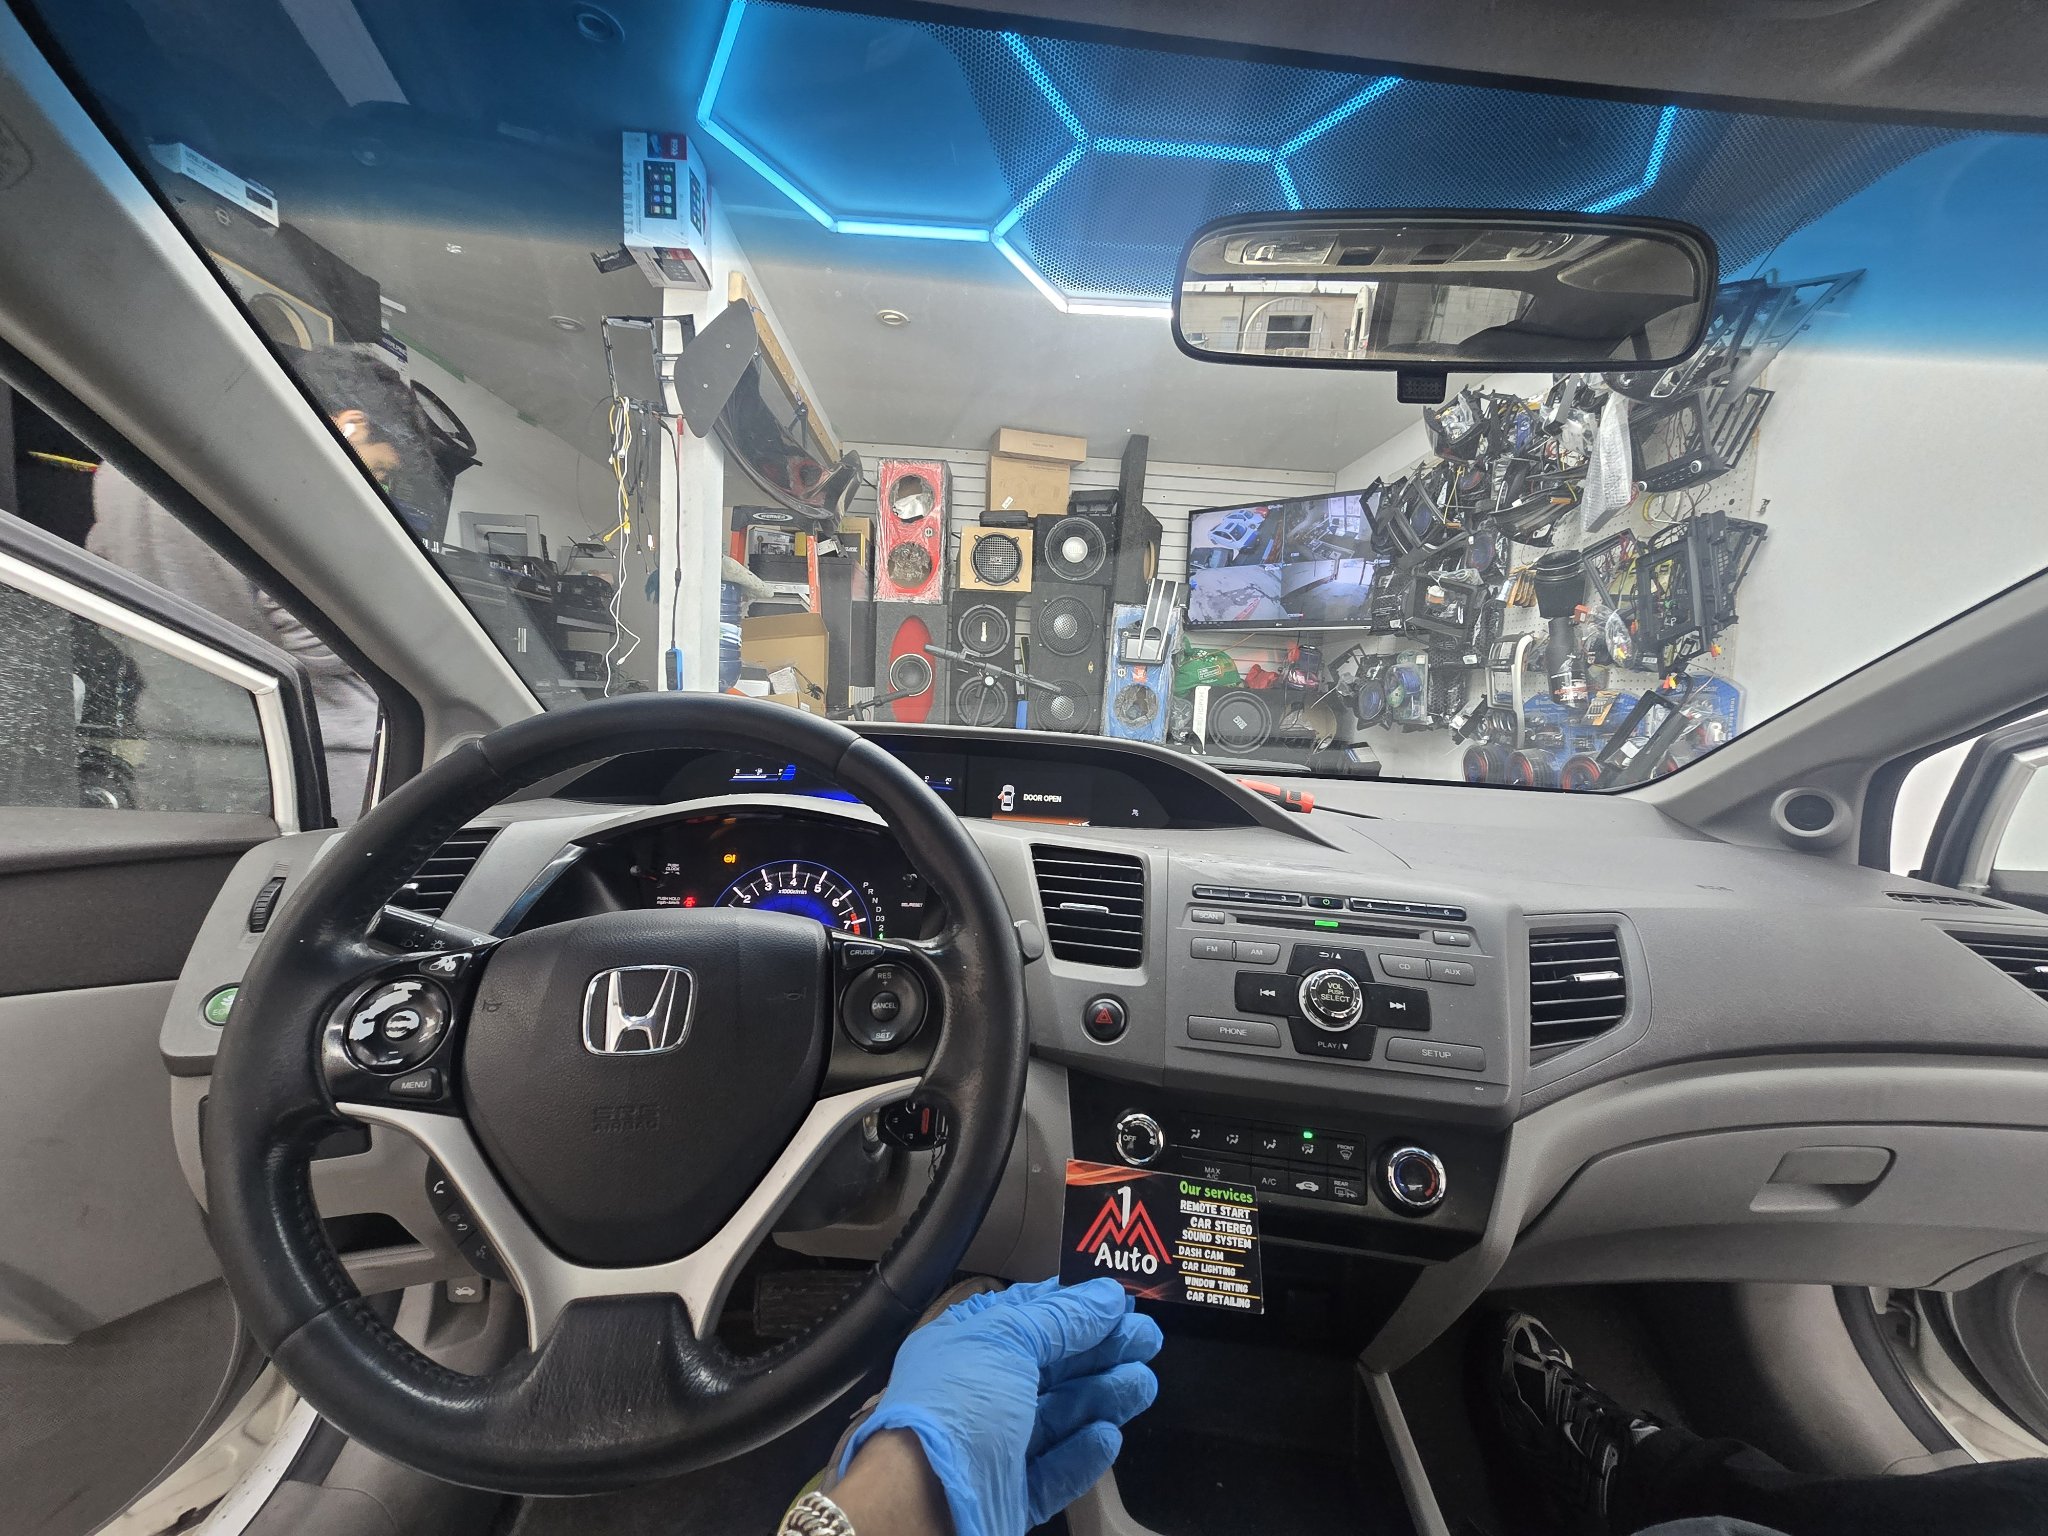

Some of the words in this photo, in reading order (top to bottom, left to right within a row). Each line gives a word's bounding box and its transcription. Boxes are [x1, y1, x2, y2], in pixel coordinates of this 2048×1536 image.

[1023, 793, 1043, 802] DOOR
[1044, 794, 1062, 803] OPEN
[764, 882, 773, 891] 3
[789, 877, 798, 887] 4
[813, 883, 822, 893] 5
[742, 894, 752, 904] 2
[831, 898, 840, 908] 6
[1199, 912, 1219, 920] SCAN
[843, 919, 851, 930] 7
[1444, 968, 1461, 976] AUX
[1326, 982, 1344, 990] VOL
[1320, 993, 1351, 1003] SELECT
[871, 1002, 896, 1010] CANCEL
[1219, 1026, 1247, 1036] PHONE
[1421, 1048, 1452, 1059] SETUP
[401, 1080, 428, 1089] MENU
[1122, 1134, 1137, 1142] OFF
[1336, 1143, 1355, 1151] FRONT
[1204, 1166, 1221, 1175] MAX
[1261, 1177, 1277, 1186] A/C
[1179, 1180, 1201, 1196] Our
[1204, 1188, 1253, 1203] services
[1180, 1199, 1218, 1215] REMOTE
[1220, 1206, 1251, 1220] START
[1190, 1216, 1212, 1230] CAR
[1214, 1220, 1253, 1236] STEREO
[1182, 1229, 1213, 1243] SOUND
[1214, 1234, 1252, 1249] SYSTEM
[1178, 1245, 1203, 1258] DASH
[1204, 1249, 1224, 1261] CAM
[1094, 1242, 1158, 1275] Auto
[1182, 1260, 1199, 1271] CAR
[1200, 1263, 1236, 1277] LIGHTING
[1184, 1275, 1216, 1289] WINDOW
[1217, 1280, 1249, 1293] TINTING
[1186, 1290, 1205, 1302] CAR
[1206, 1293, 1251, 1309] DETAILING
